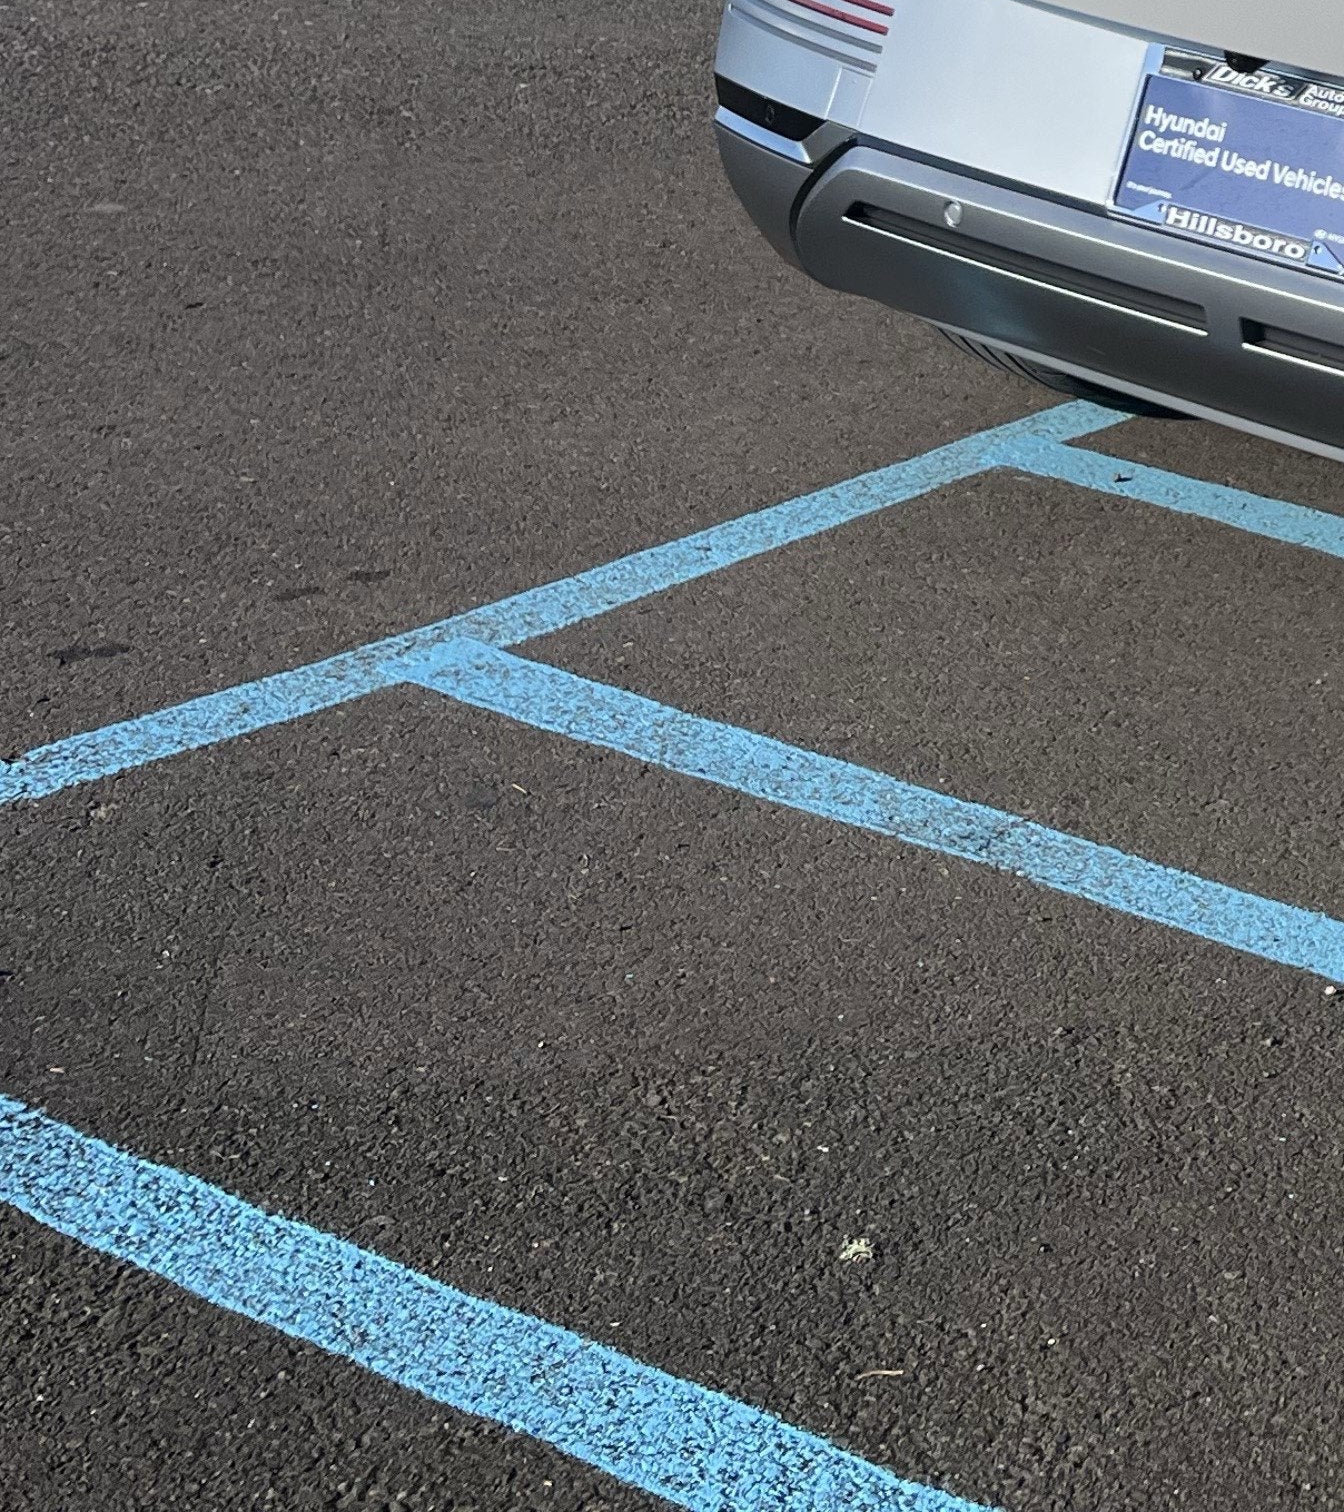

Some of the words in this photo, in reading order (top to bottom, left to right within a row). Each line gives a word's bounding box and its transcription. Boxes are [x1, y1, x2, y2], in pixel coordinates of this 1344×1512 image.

[1210, 65, 1296, 99] Dick's
[1145, 105, 1227, 144] Hyundai
[1137, 130, 1219, 169] Certified
[1220, 151, 1270, 182] Used
[1165, 207, 1307, 260] Hillsboro
